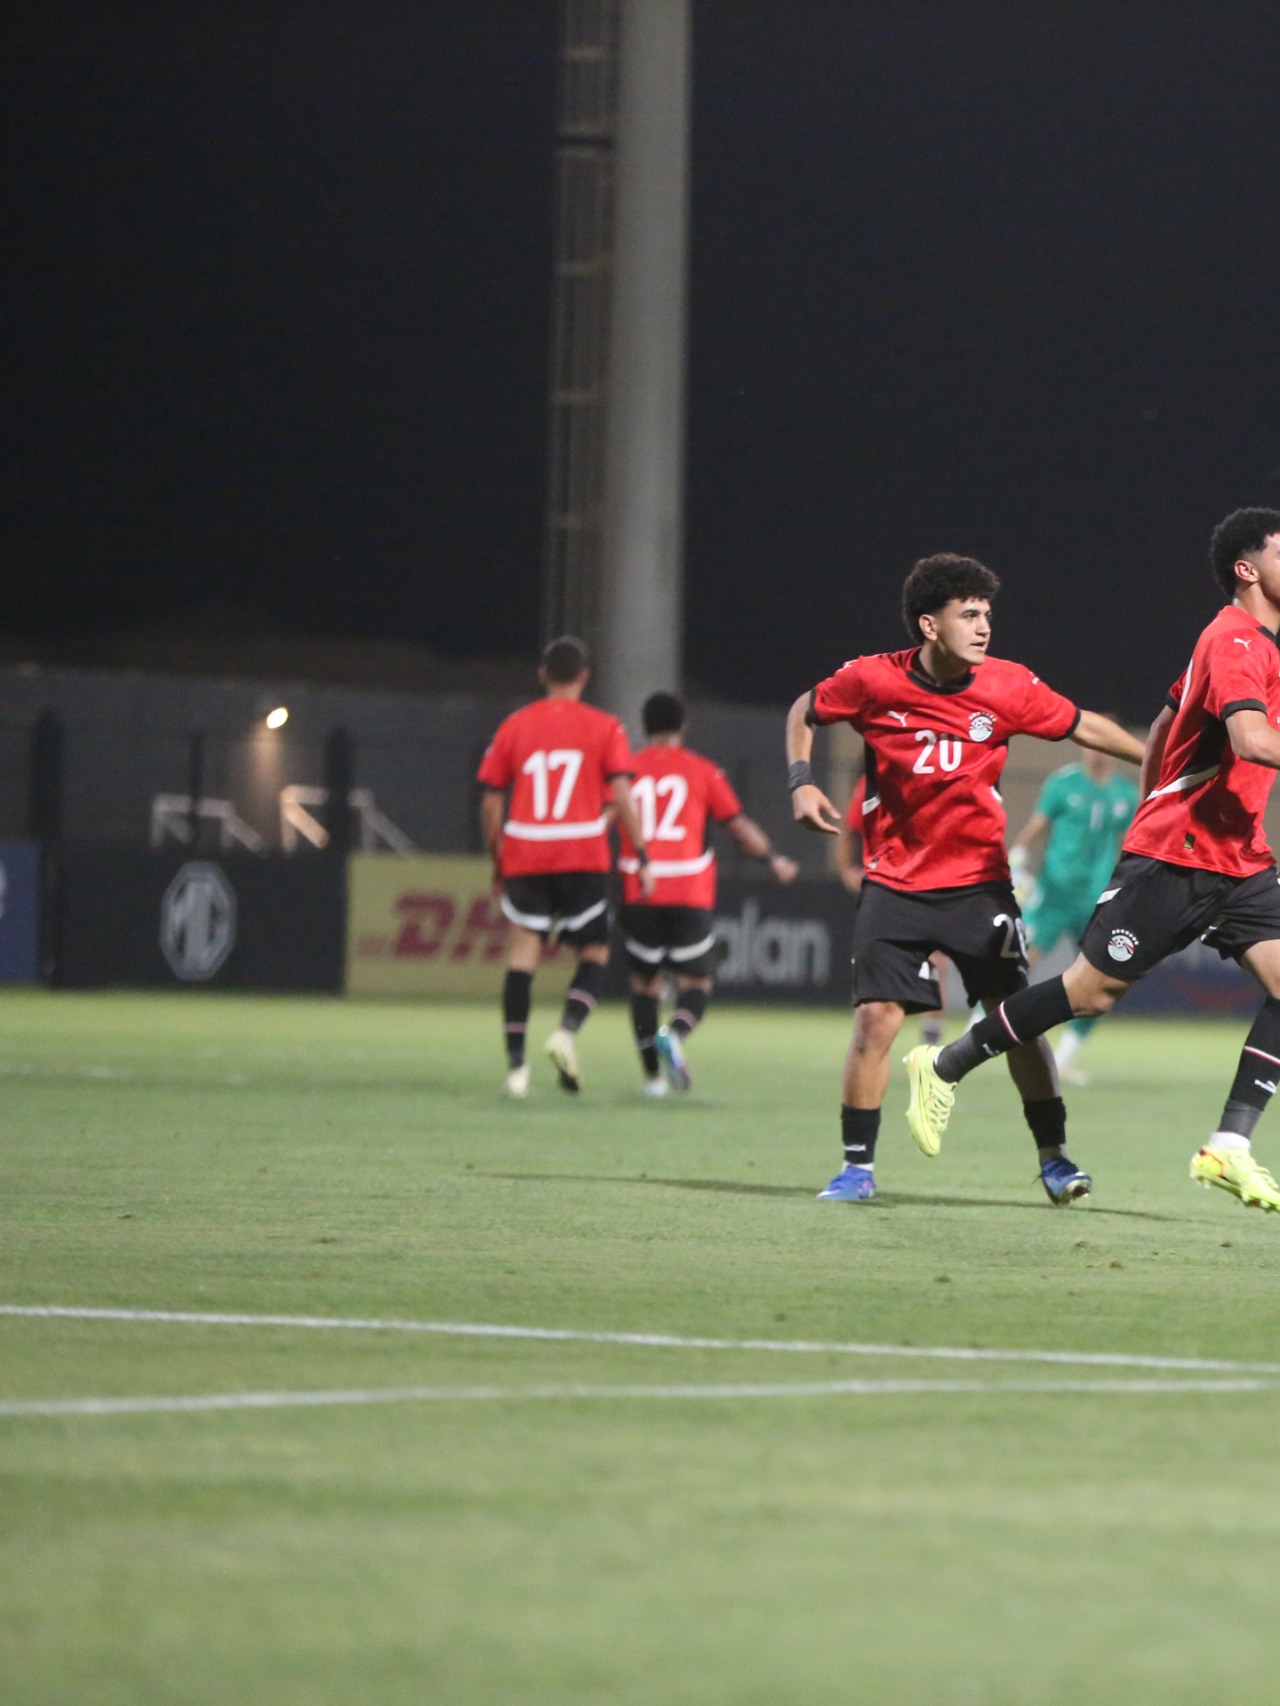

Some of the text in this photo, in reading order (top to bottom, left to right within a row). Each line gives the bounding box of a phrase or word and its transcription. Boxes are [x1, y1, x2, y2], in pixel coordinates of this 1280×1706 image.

[523, 749, 583, 820] 17
[912, 729, 962, 774] 20
[630, 774, 688, 842] 12
[709, 899, 832, 986] alan
